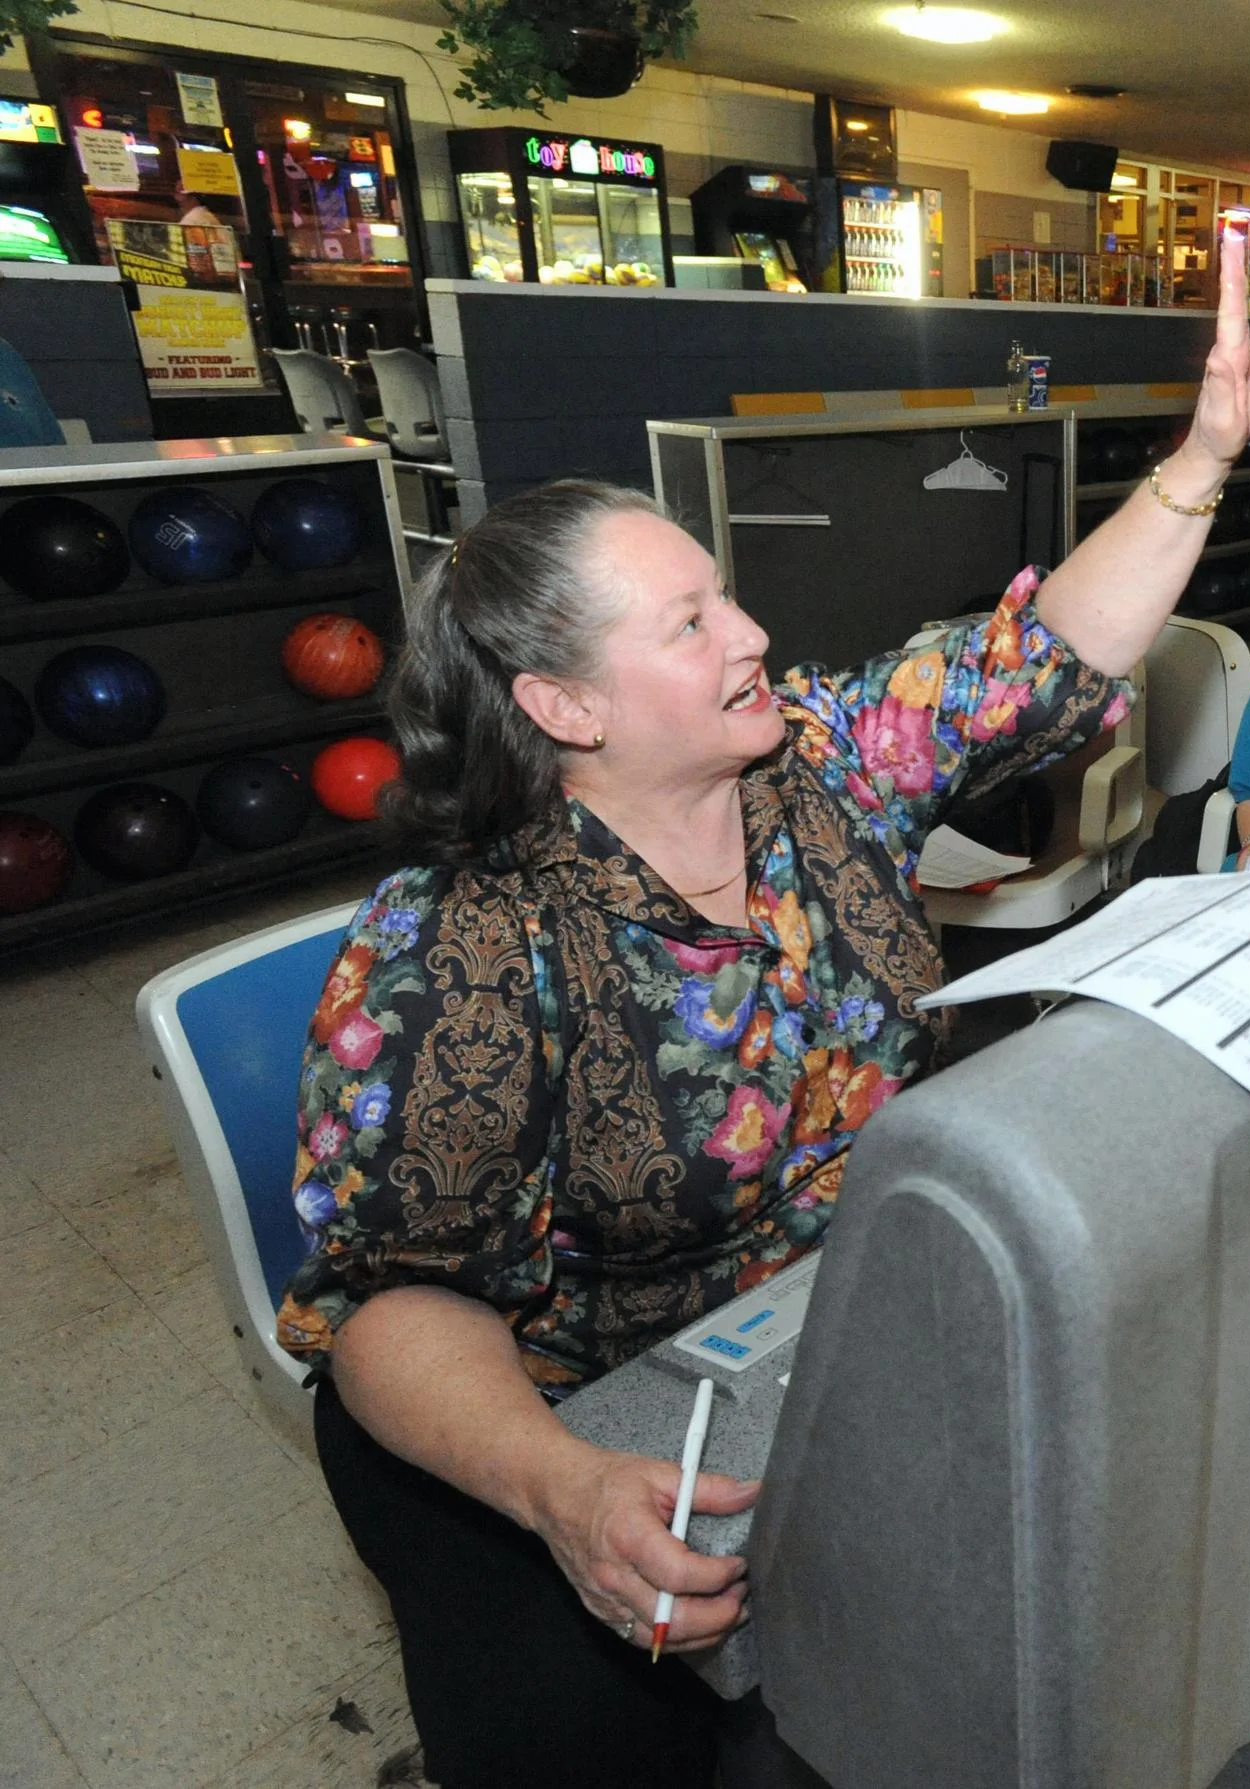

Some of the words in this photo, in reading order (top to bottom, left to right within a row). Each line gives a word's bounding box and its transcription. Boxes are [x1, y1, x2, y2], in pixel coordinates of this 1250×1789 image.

[526, 137, 567, 171] toy
[599, 145, 655, 177] house
[172, 367, 197, 379] AND
[225, 366, 256, 379] LIGHT
